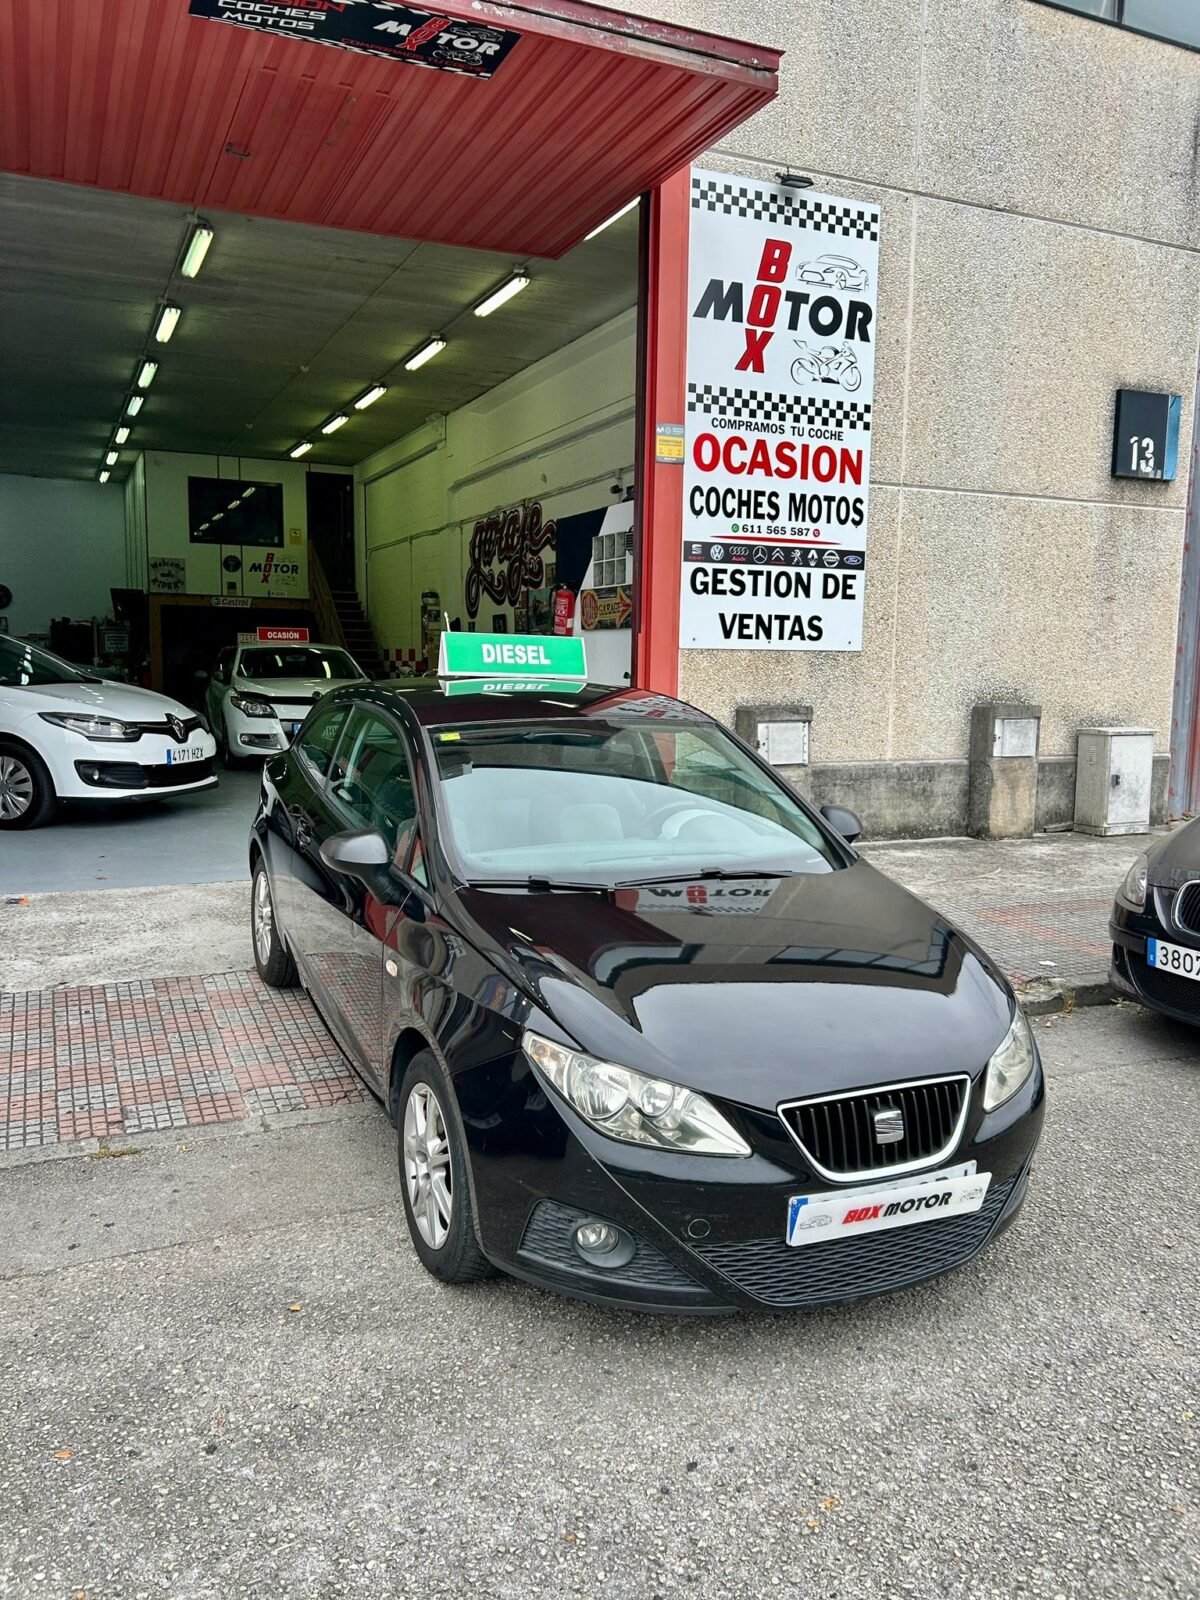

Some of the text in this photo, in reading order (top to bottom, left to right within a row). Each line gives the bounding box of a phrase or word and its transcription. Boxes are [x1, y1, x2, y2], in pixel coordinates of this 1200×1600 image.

[217, 0, 327, 21] COCHES
[222, 11, 315, 30] MOTOS
[373, 20, 500, 55] MOTOR
[693, 279, 873, 343] MOTOR
[735, 238, 792, 374] BOX
[711, 417, 844, 441] COMPRAMOS TU COCHE
[693, 433, 863, 485] OCASION
[1130, 436, 1154, 473] 13
[690, 485, 864, 527] COCHES MOTOS
[742, 524, 810, 537] 611 565 587
[248, 562, 299, 575] MOTOR
[690, 567, 857, 600] GESTION DE
[267, 631, 300, 640] OCASIÓN
[718, 612, 823, 642] VENTAS
[482, 643, 552, 665] DIESEL
[172, 747, 204, 762] 4171 HZX
[883, 1191, 953, 1217] MOTOR
